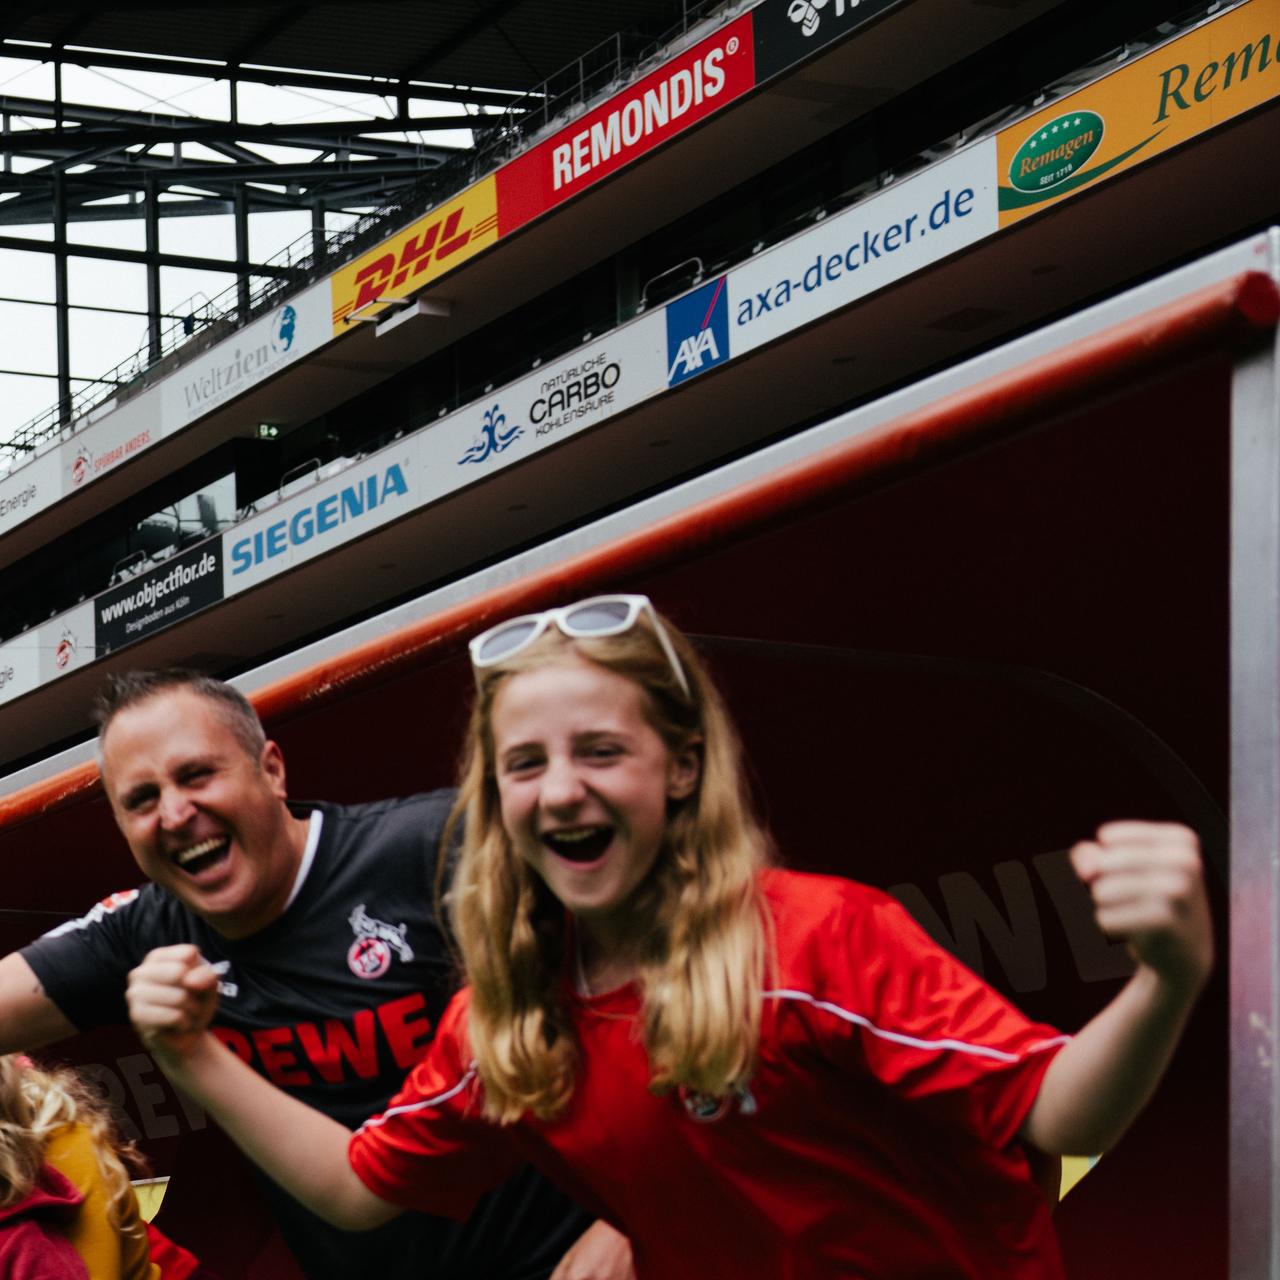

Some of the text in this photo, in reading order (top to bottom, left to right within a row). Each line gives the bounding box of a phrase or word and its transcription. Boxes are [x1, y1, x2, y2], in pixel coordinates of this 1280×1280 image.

[1151, 33, 1280, 126] Rem
[1019, 129, 1094, 178] Remagen
[1040, 173, 1055, 185] SEIT
[353, 206, 474, 310] DHL
[736, 187, 975, 327] axa-decker.de
[184, 344, 269, 408] Weltzien
[540, 352, 607, 394] NATÜRLICHE
[668, 327, 720, 383] AXA
[529, 362, 621, 424] CARBO
[535, 391, 615, 438] KOHLENSÄURE
[231, 463, 409, 576] SIEGENIA
[101, 552, 216, 624] www.objectflor.de
